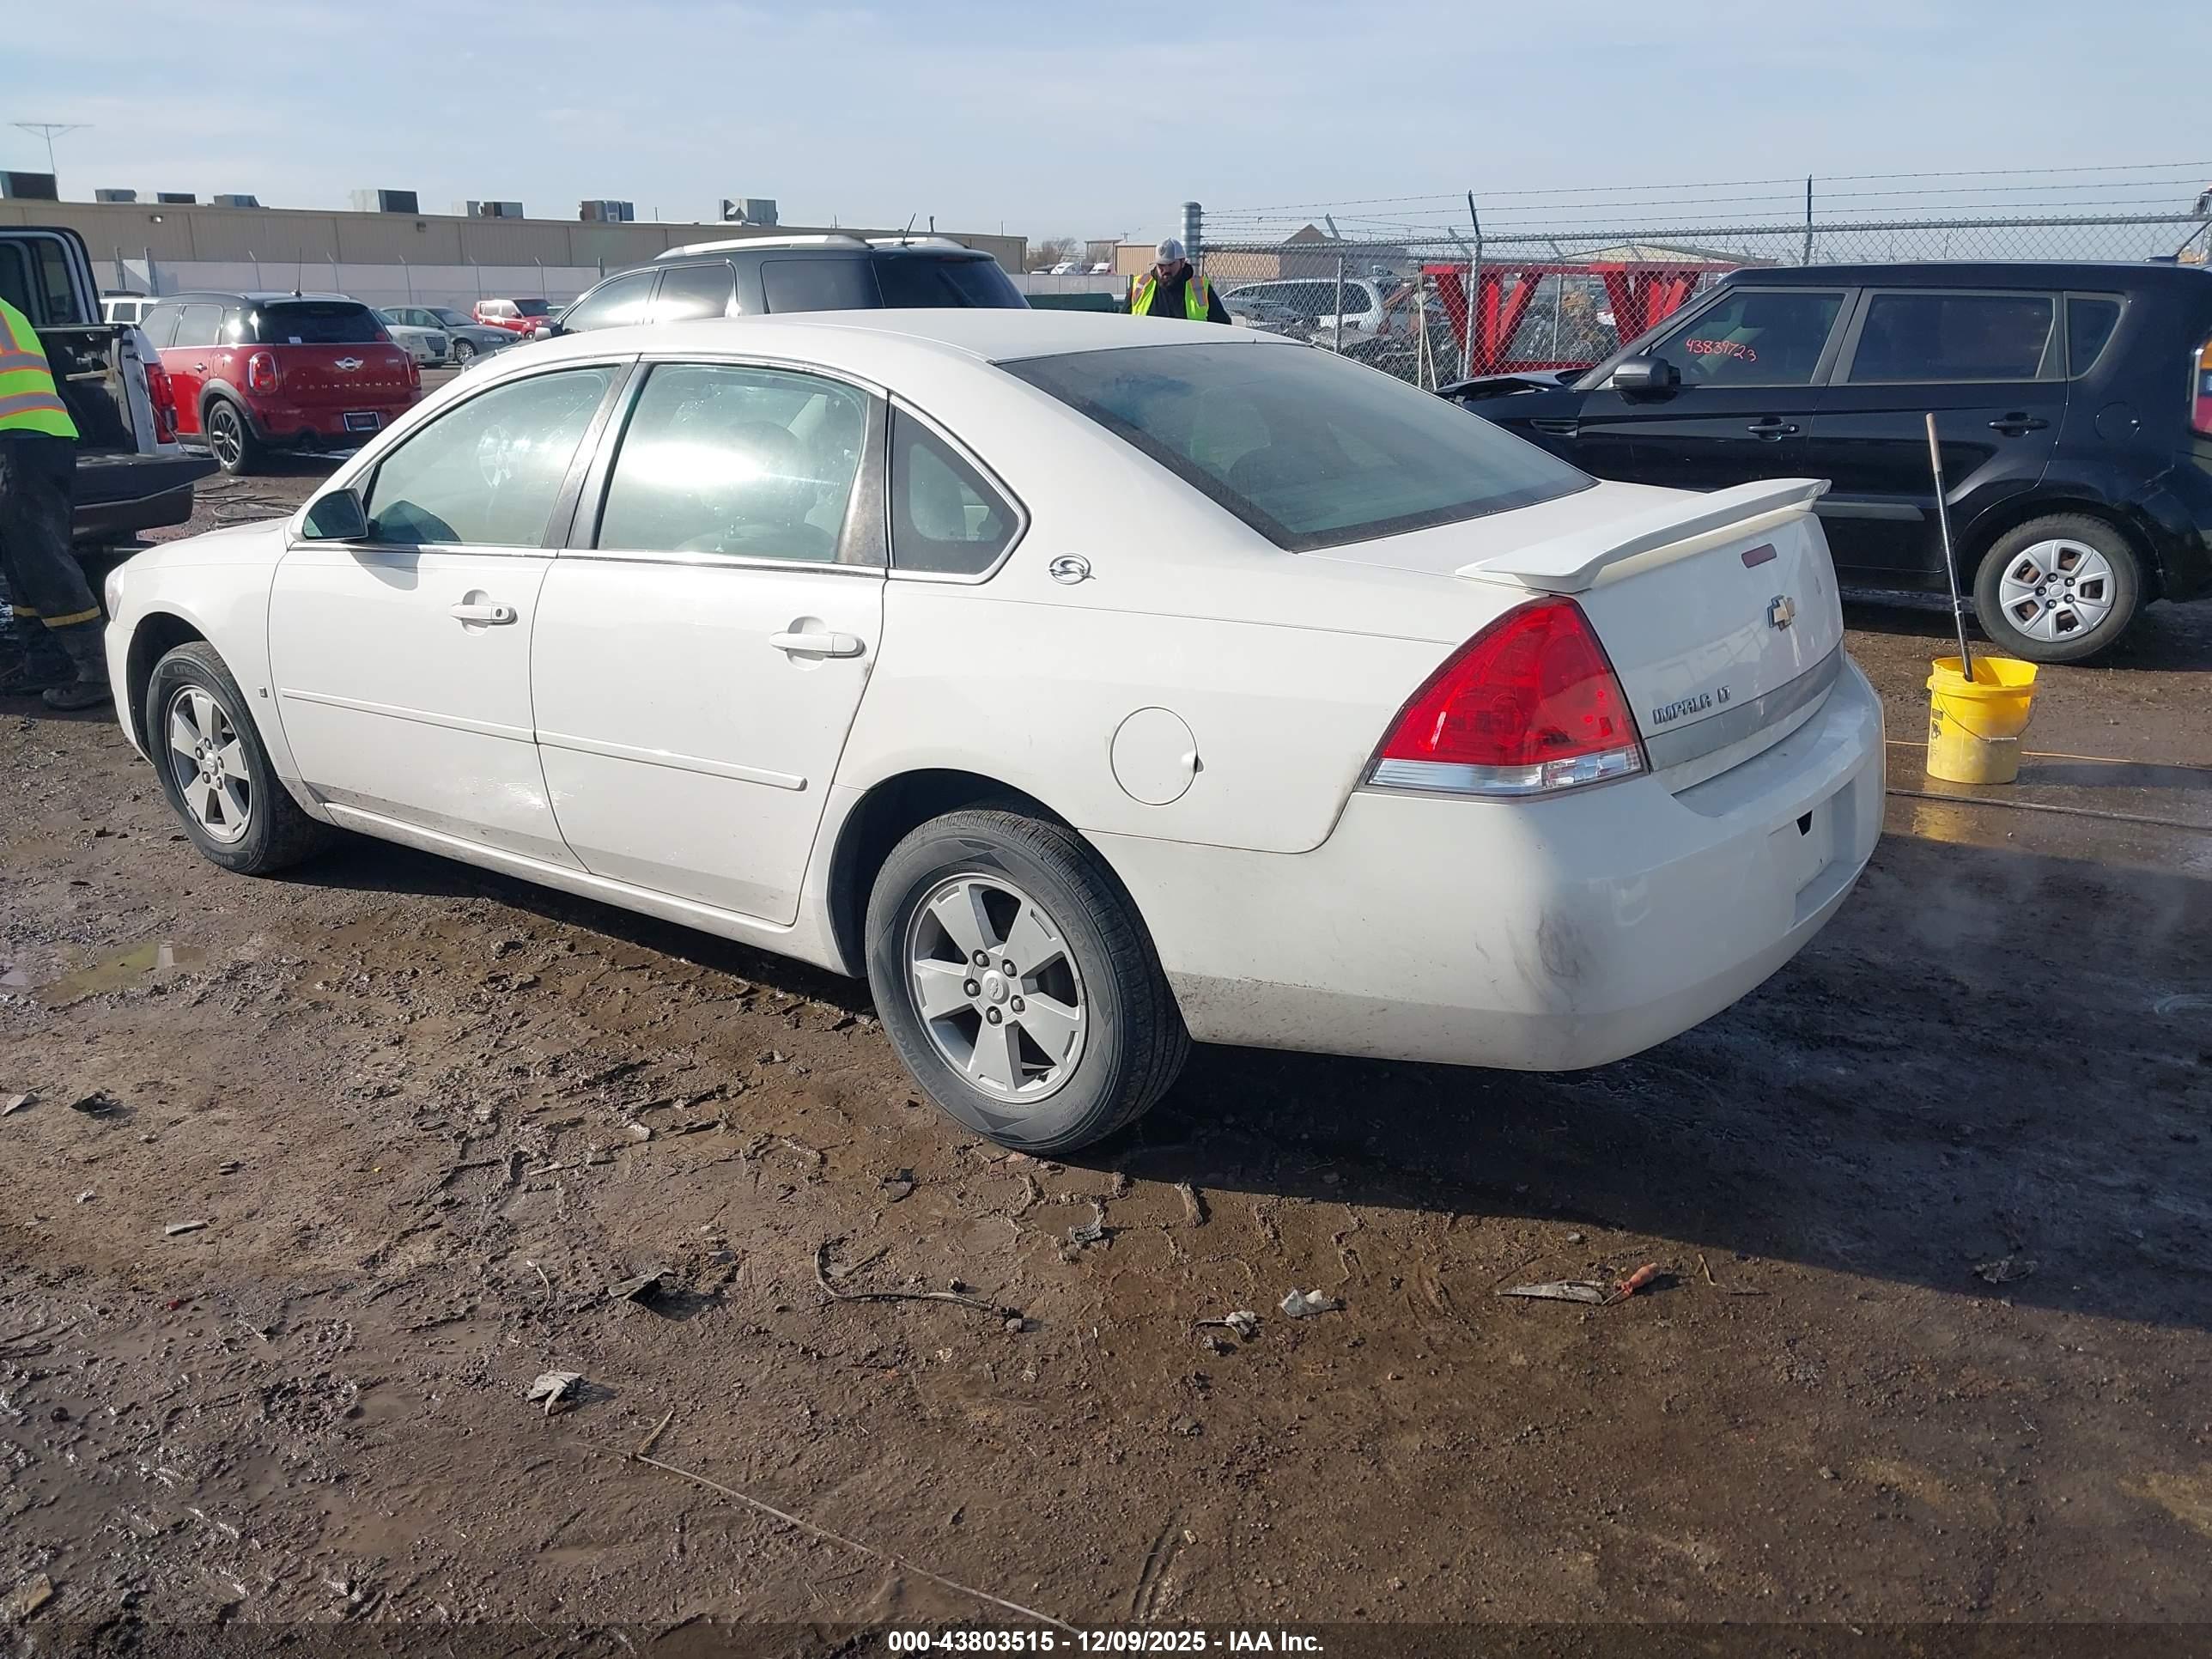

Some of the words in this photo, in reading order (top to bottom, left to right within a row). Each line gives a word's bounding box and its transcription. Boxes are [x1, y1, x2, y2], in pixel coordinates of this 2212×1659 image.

[1686, 337, 1758, 362] 43839723
[1652, 692, 1713, 725] IMPALA
[1717, 684, 1731, 703] LT
